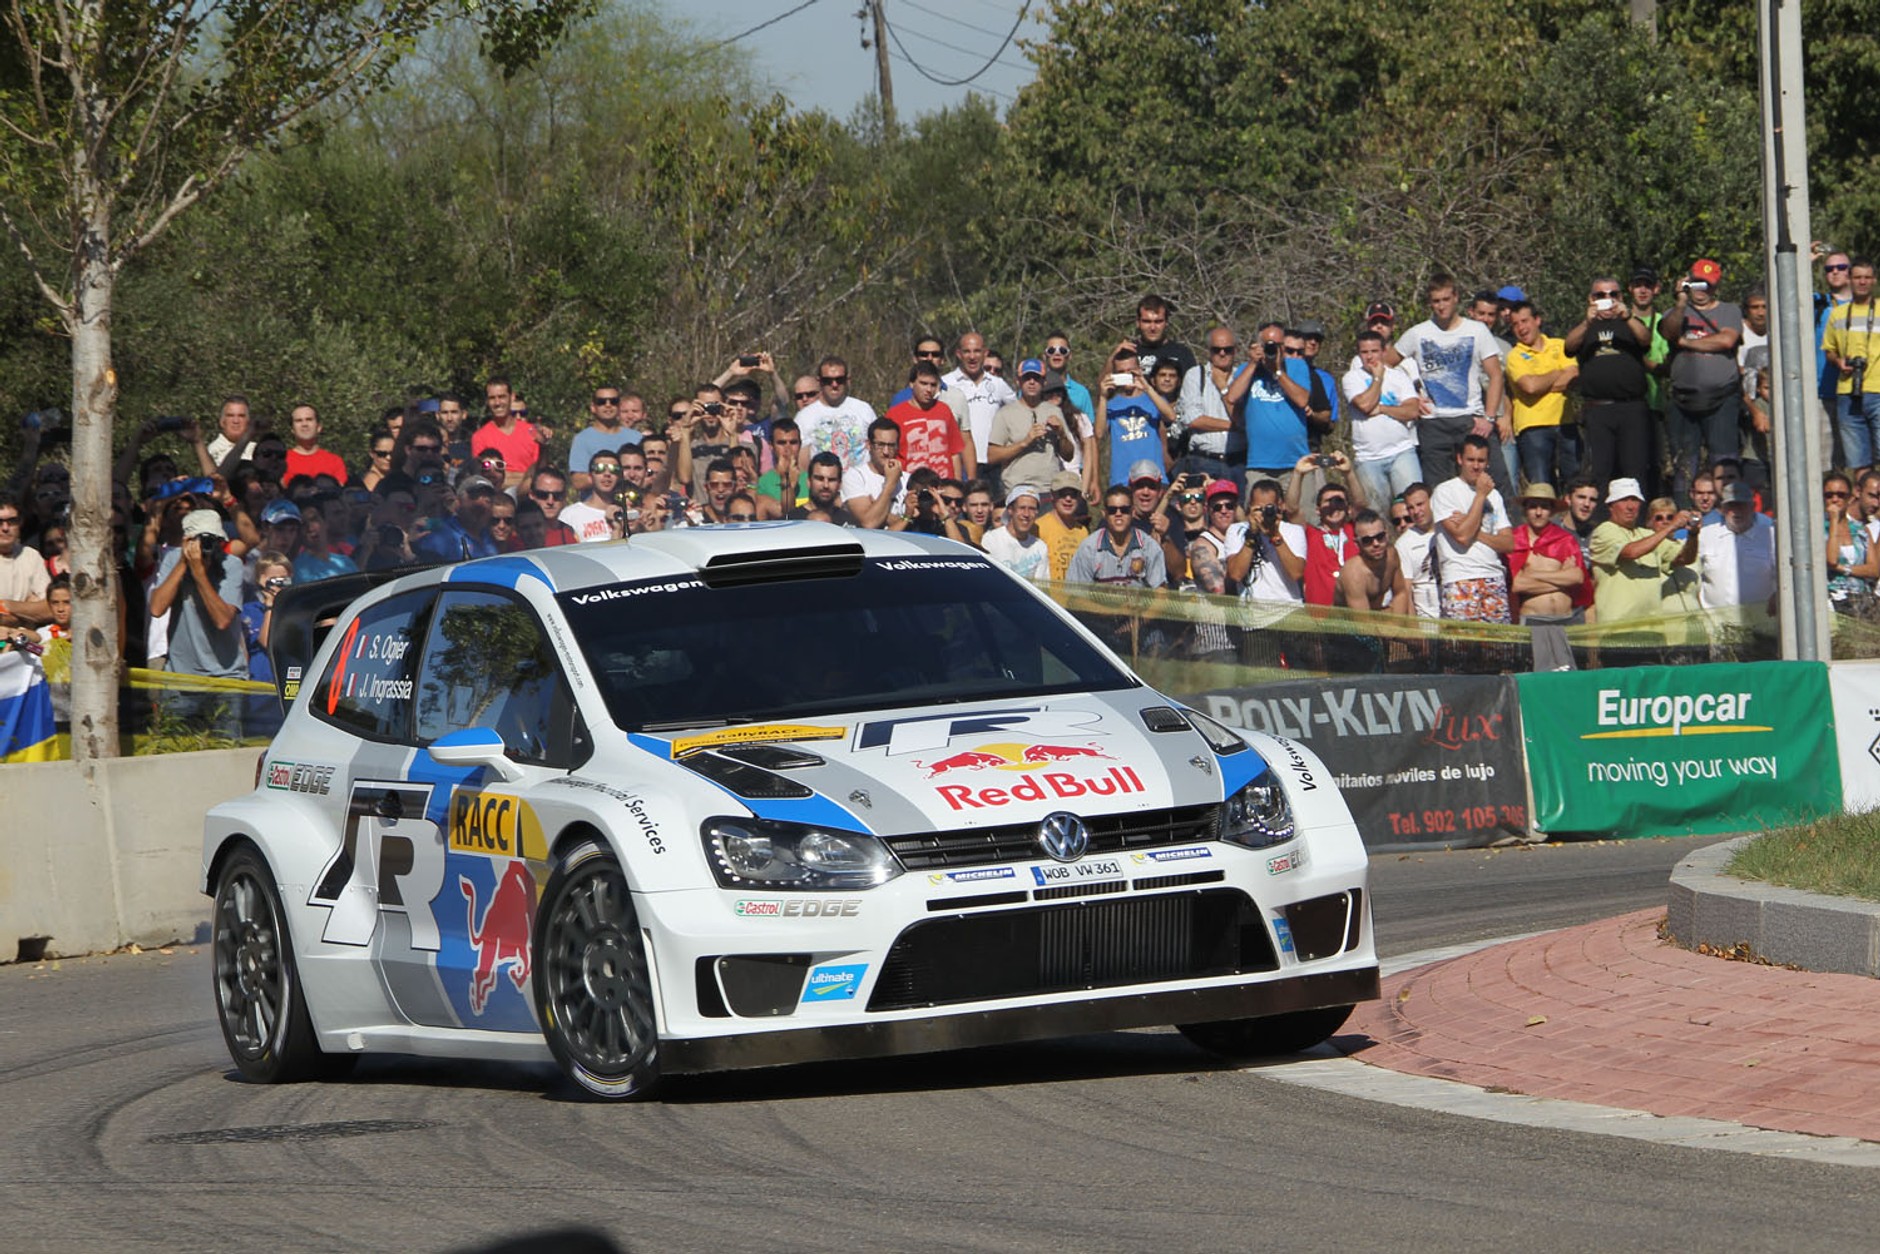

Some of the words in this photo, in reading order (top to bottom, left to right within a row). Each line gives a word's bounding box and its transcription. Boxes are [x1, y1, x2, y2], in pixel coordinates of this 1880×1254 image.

[875, 560, 990, 572] Volkswagen
[572, 579, 704, 605] Volkswagen
[369, 635, 380, 659] S.
[381, 635, 409, 665] Ogier
[359, 673, 369, 697] J.
[369, 674, 413, 704] Ingrassia
[1423, 704, 1503, 750] Lux
[1598, 689, 1752, 736] Europcar
[290, 763, 336, 795] EDGE
[1334, 772, 1383, 789] nitarios
[1441, 765, 1462, 780] de
[1465, 763, 1495, 781] lujo
[1588, 757, 1669, 787] moving
[1674, 757, 1722, 787] your
[1729, 755, 1777, 780] way
[935, 775, 1047, 810] Red
[1042, 766, 1145, 798] Bull
[455, 795, 511, 851] RACC
[625, 799, 666, 854] Services
[1387, 811, 1420, 835] Tel.
[1423, 809, 1456, 833] 902
[1461, 805, 1497, 831] 105
[1155, 847, 1209, 861] MICHELIN
[954, 867, 1013, 880] MICHELIN
[1043, 867, 1071, 880] WOB
[1076, 863, 1095, 876] VW
[1096, 861, 1120, 875] 361
[745, 902, 779, 915] Castrol
[782, 899, 863, 917] EDGE
[811, 971, 854, 984] ultimate
